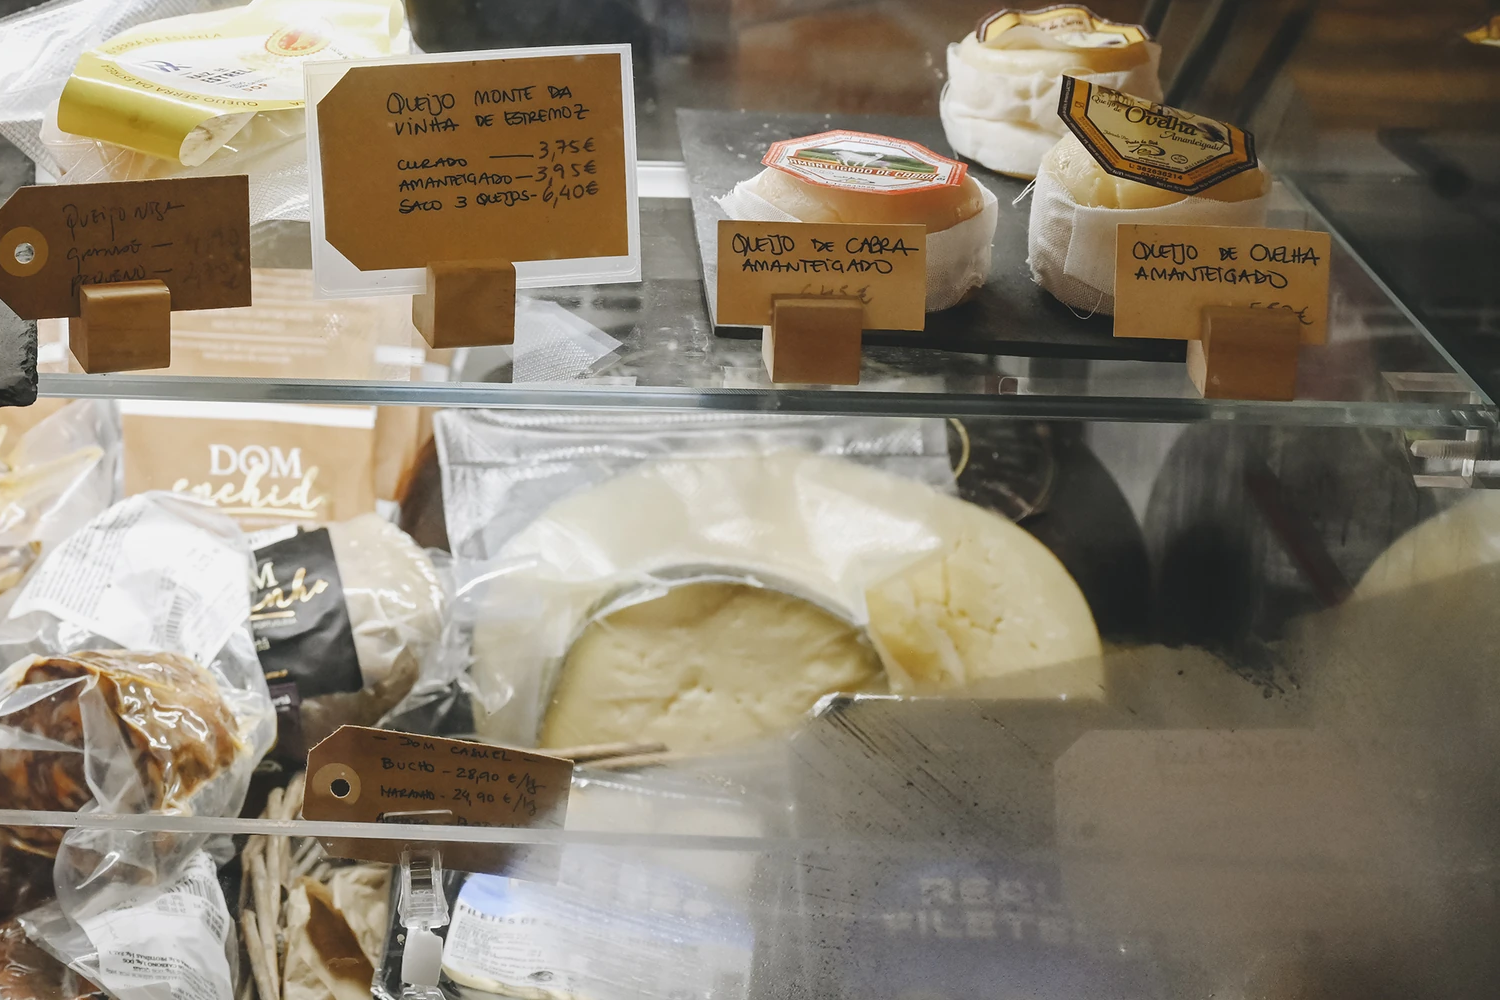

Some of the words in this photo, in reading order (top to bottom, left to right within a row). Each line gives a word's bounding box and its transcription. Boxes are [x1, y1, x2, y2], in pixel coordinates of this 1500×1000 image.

[386, 92, 456, 116] QUEIJO
[474, 85, 536, 106] MONTE
[547, 85, 572, 99] DA
[1091, 94, 1116, 109] Queijo
[395, 115, 460, 136] VINHA
[475, 114, 494, 127] DE
[504, 103, 590, 126] ESTREMOZ
[1125, 106, 1198, 136] Ovelha
[1159, 130, 1225, 151] Amanteigado
[397, 157, 468, 171] CURADO
[399, 173, 513, 192] AMANTEIGADO
[399, 198, 442, 214] SACO
[454, 195, 468, 208] 3
[62, 203, 126, 242] QUEIJO
[732, 233, 795, 256] QUEIJO
[811, 238, 834, 252] DE
[846, 235, 919, 256] CABRA
[1132, 241, 1198, 265] QUEIJO
[1219, 247, 1238, 261] DE
[1250, 243, 1320, 266] OVELHA
[742, 258, 893, 275] AMANTEIGADO
[1134, 266, 1288, 289] AMANTEIGADO
[208, 444, 303, 479] DOM
[400, 736, 435, 751] DOM
[381, 757, 435, 773] BUCHO
[380, 785, 436, 801] MARANHO
